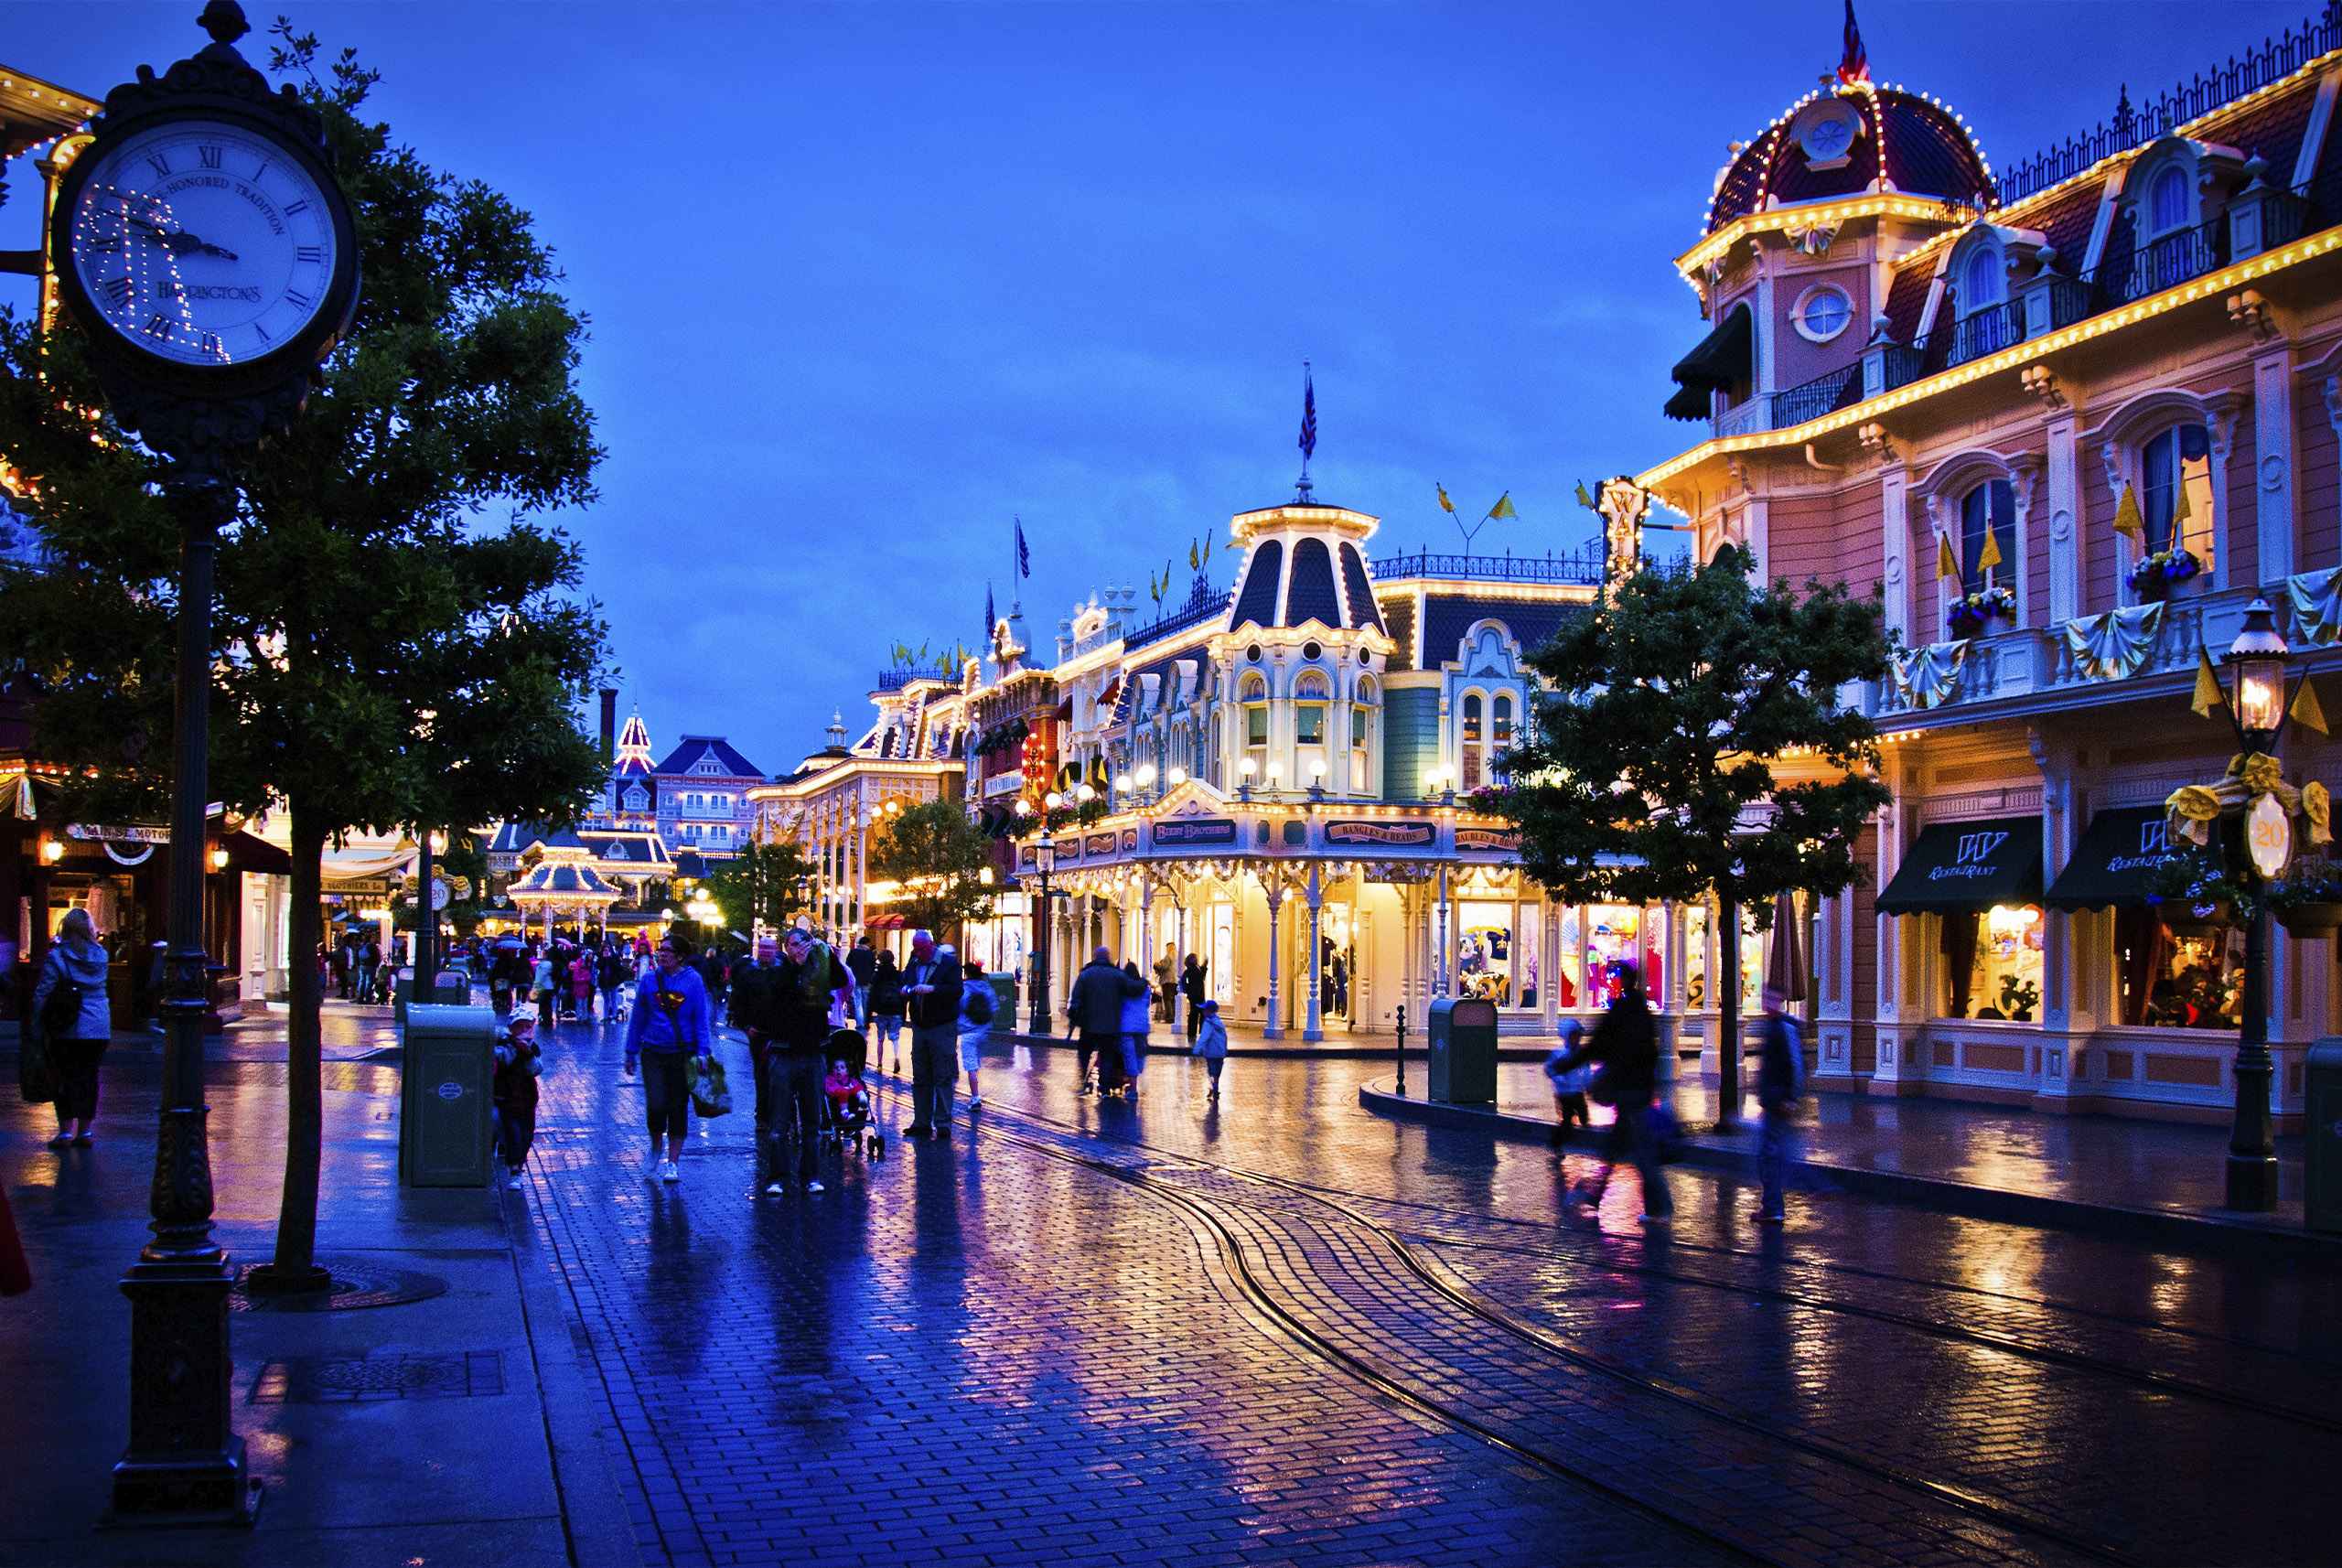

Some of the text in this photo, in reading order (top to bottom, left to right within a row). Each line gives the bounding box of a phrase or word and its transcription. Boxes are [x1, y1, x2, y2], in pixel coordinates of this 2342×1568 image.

[146, 153, 171, 179] XI
[198, 145, 221, 169] XII
[234, 183, 284, 236] TRADITION
[157, 282, 261, 303] HARINGTON'S
[1341, 825, 1379, 836] BANGLES
[1390, 832, 1417, 843] BEADS
[2255, 821, 2283, 848] 20
[1957, 831, 2010, 865] W
